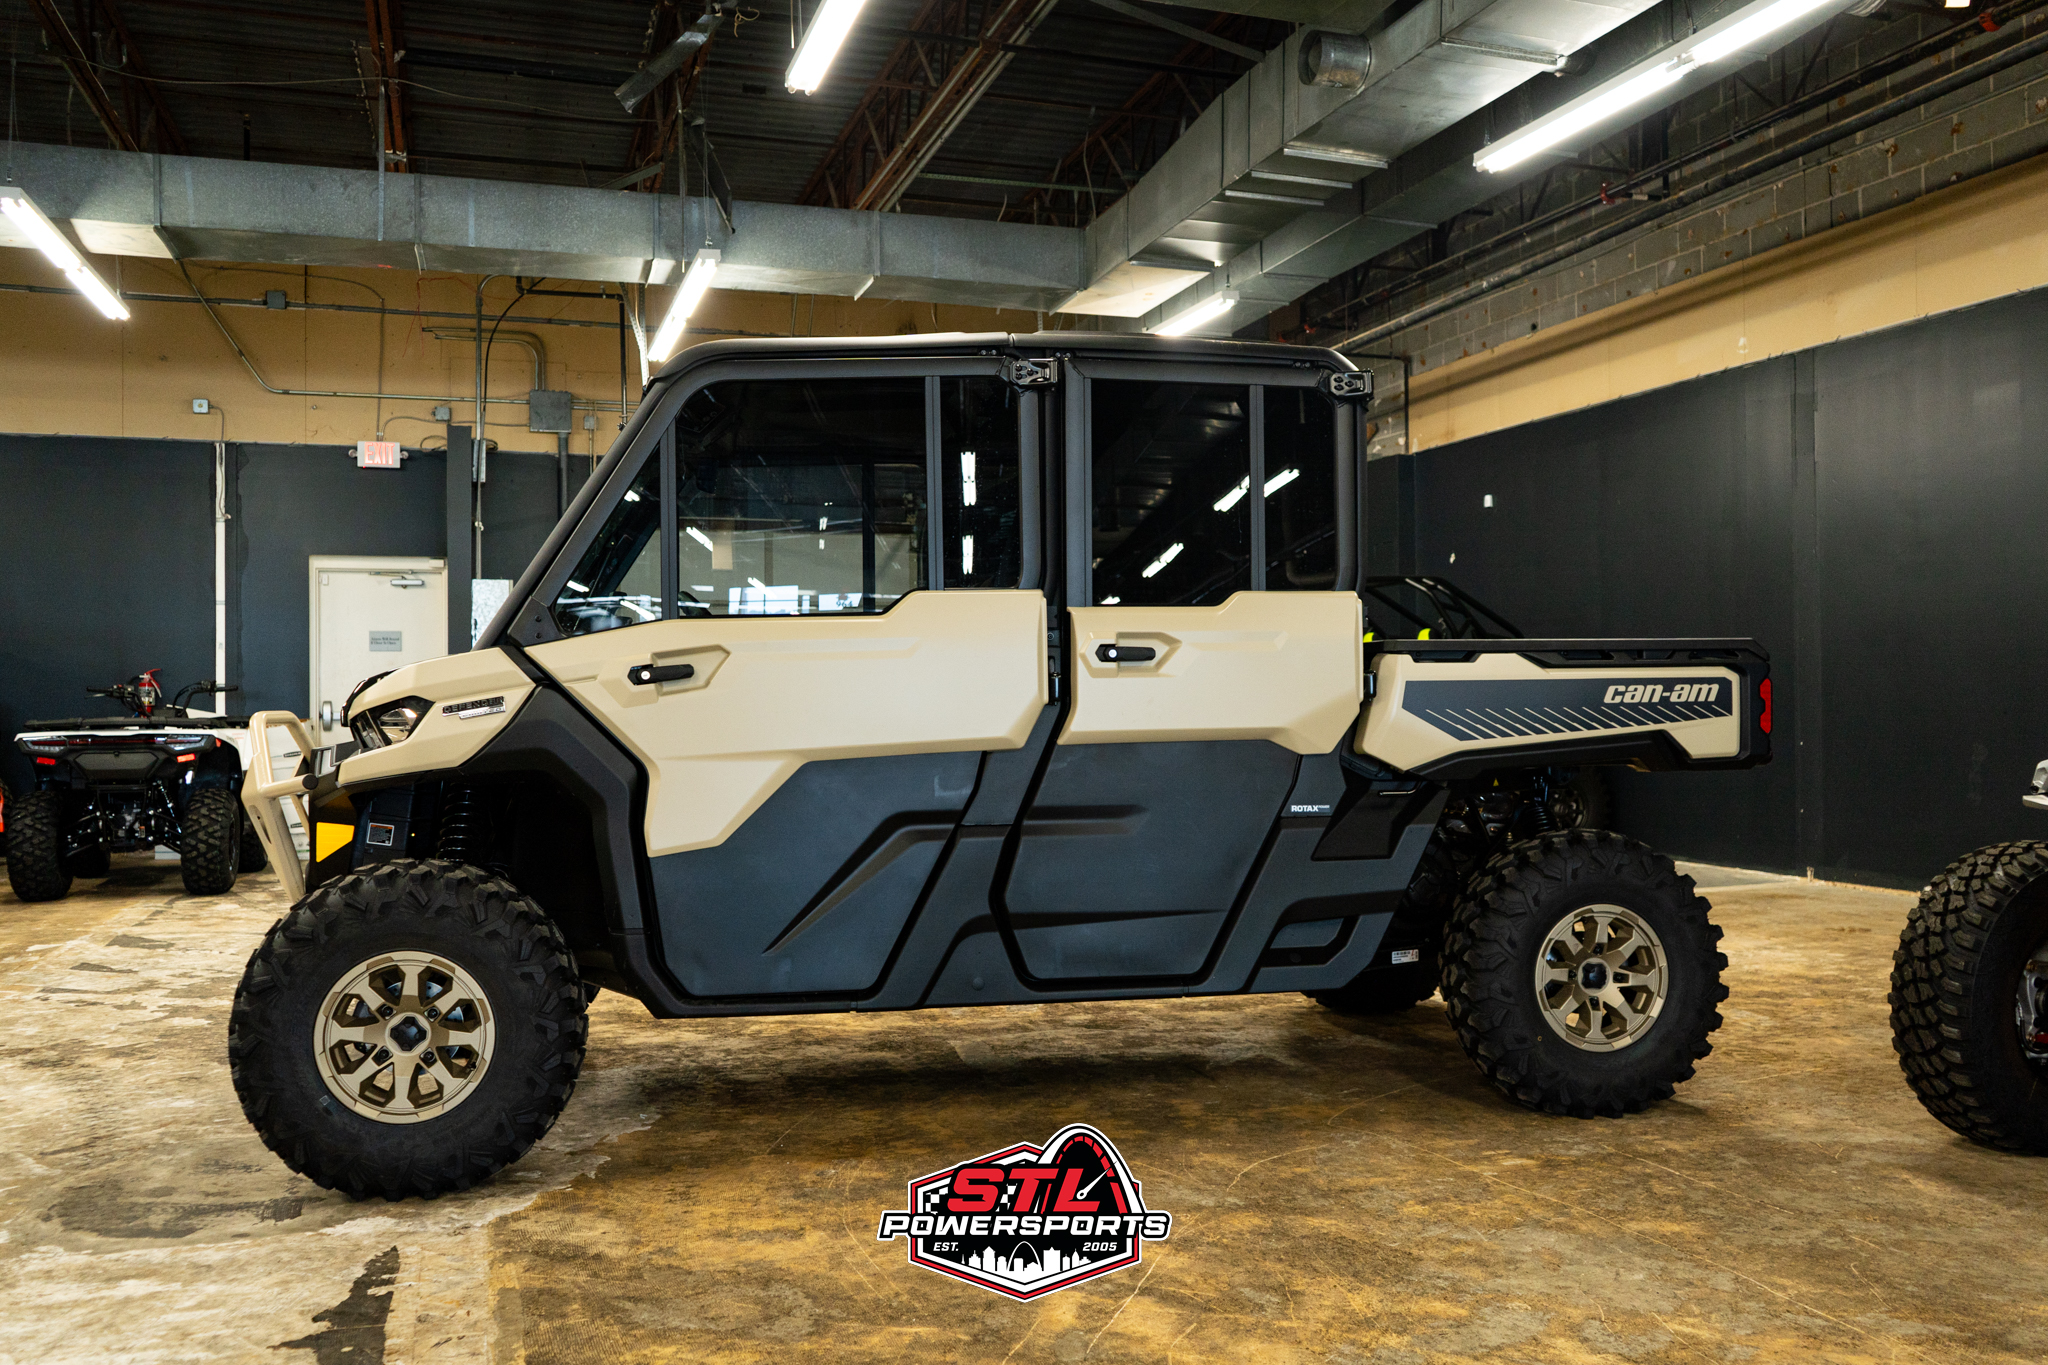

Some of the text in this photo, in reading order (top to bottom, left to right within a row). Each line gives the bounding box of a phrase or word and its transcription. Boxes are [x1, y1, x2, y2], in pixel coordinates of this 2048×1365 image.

[364, 441, 396, 466] EXIT
[1603, 683, 1720, 704] can-am
[1291, 804, 1319, 813] ROTAX
